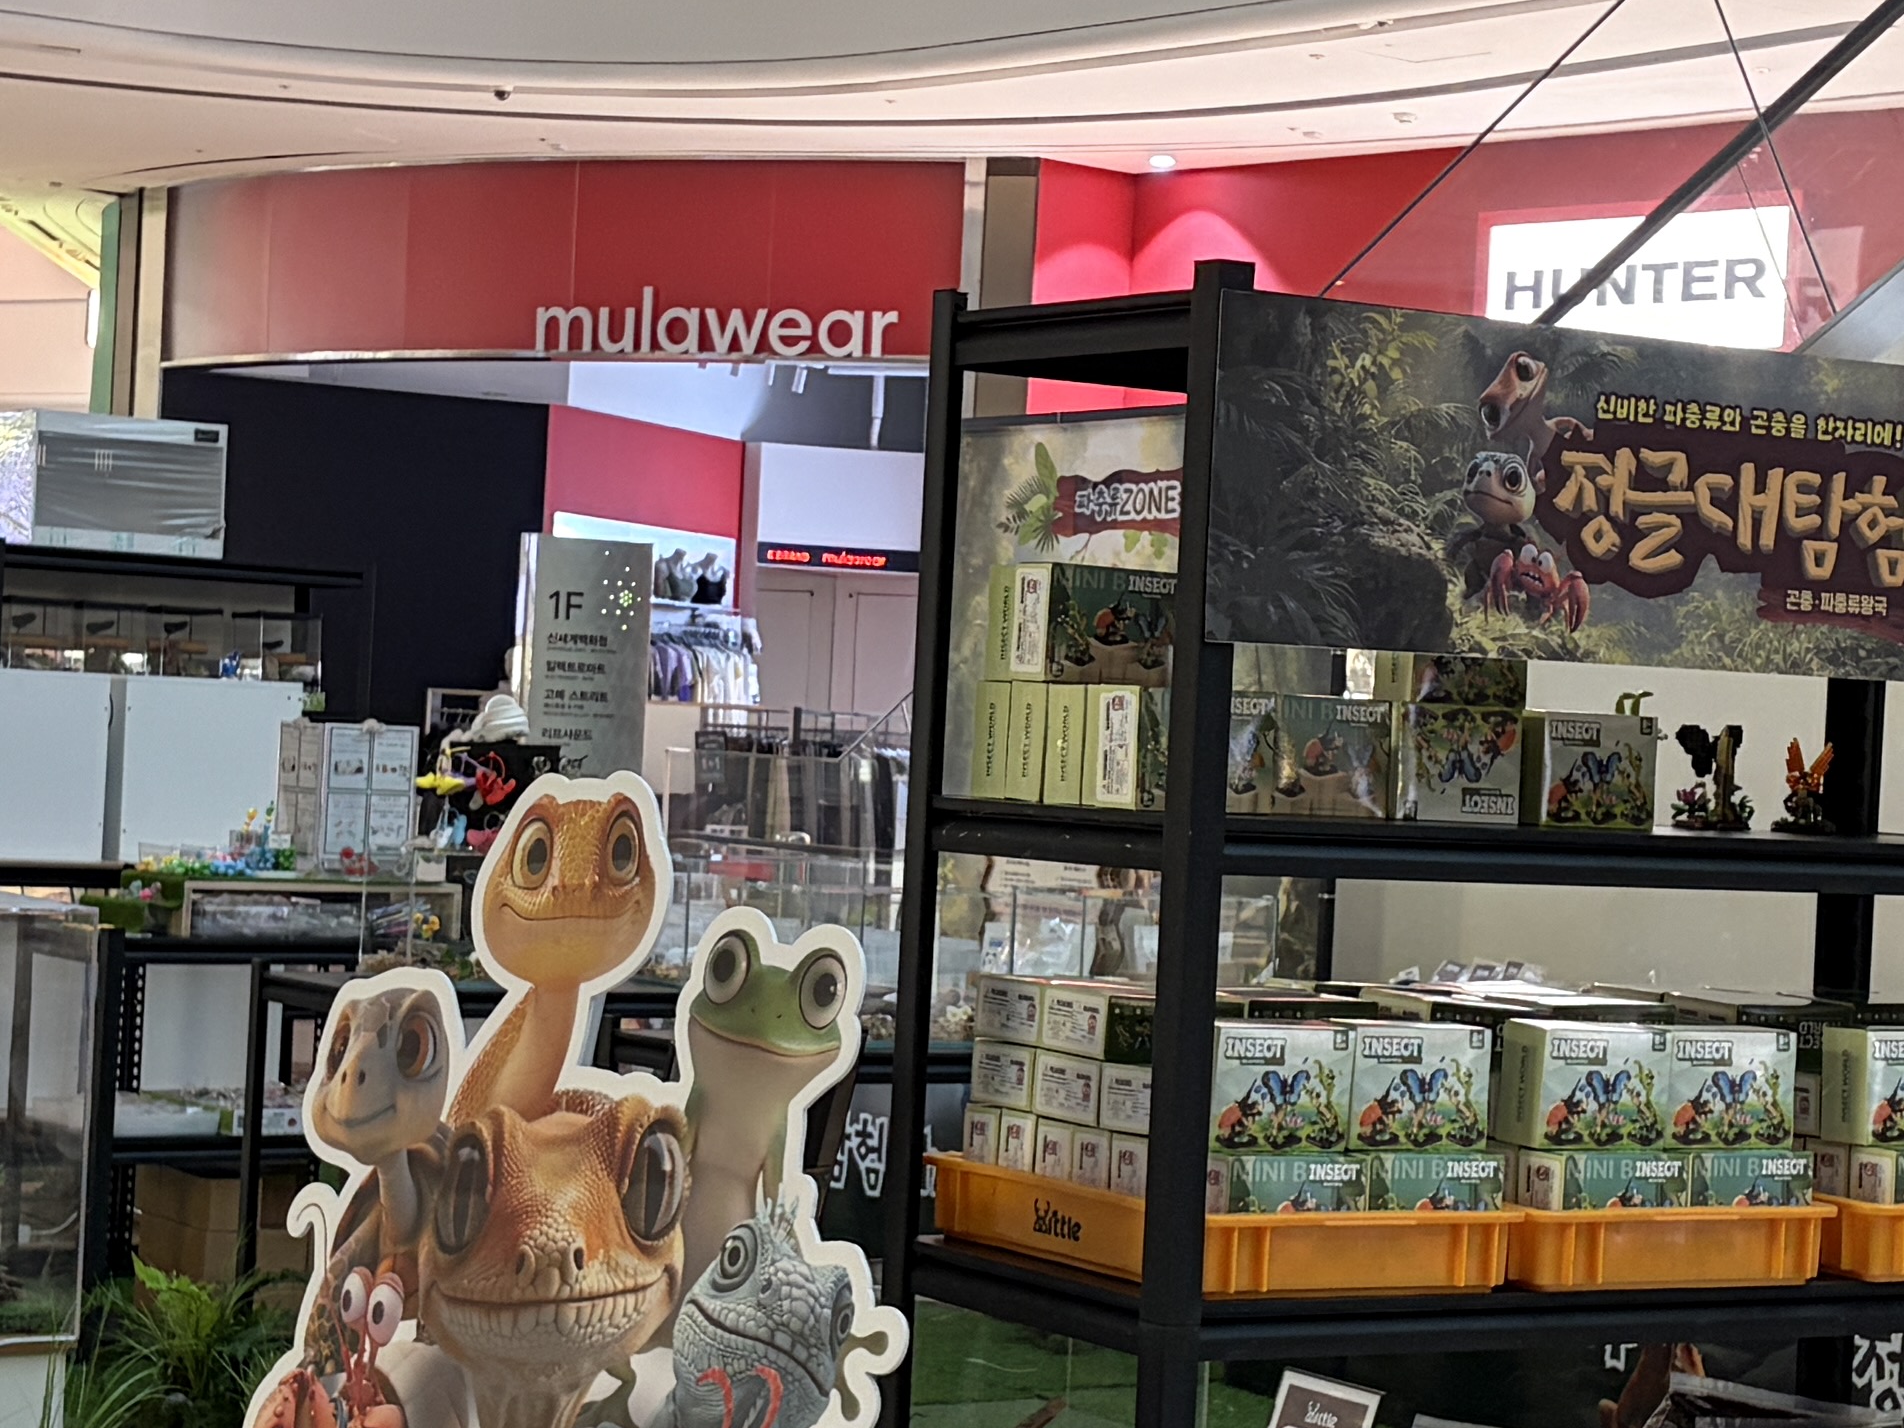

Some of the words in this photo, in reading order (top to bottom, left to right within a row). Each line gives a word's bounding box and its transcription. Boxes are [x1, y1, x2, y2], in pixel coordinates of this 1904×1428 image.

[536, 286, 899, 358] mulawear
[1597, 393, 1656, 423] 신비한
[1663, 402, 1742, 432] 파충류와
[1750, 409, 1808, 439] 곤충을
[1816, 416, 1904, 449] 한자리에!
[1128, 575, 1178, 595] INSECT
[549, 590, 584, 620] 1F
[1336, 703, 1385, 723] INSECT
[1551, 721, 1600, 741] INSECT
[1462, 794, 1515, 815] INSECT
[1226, 1037, 1286, 1059] INSECT
[1363, 1036, 1423, 1057] INSECT
[1552, 1038, 1610, 1058] INSECT
[1676, 1039, 1733, 1059] INSECT
[1308, 1162, 1361, 1182] INSECT
[1446, 1160, 1498, 1179] INSECT
[1635, 1160, 1682, 1178] INSECT
[1761, 1158, 1808, 1177] INSECT
